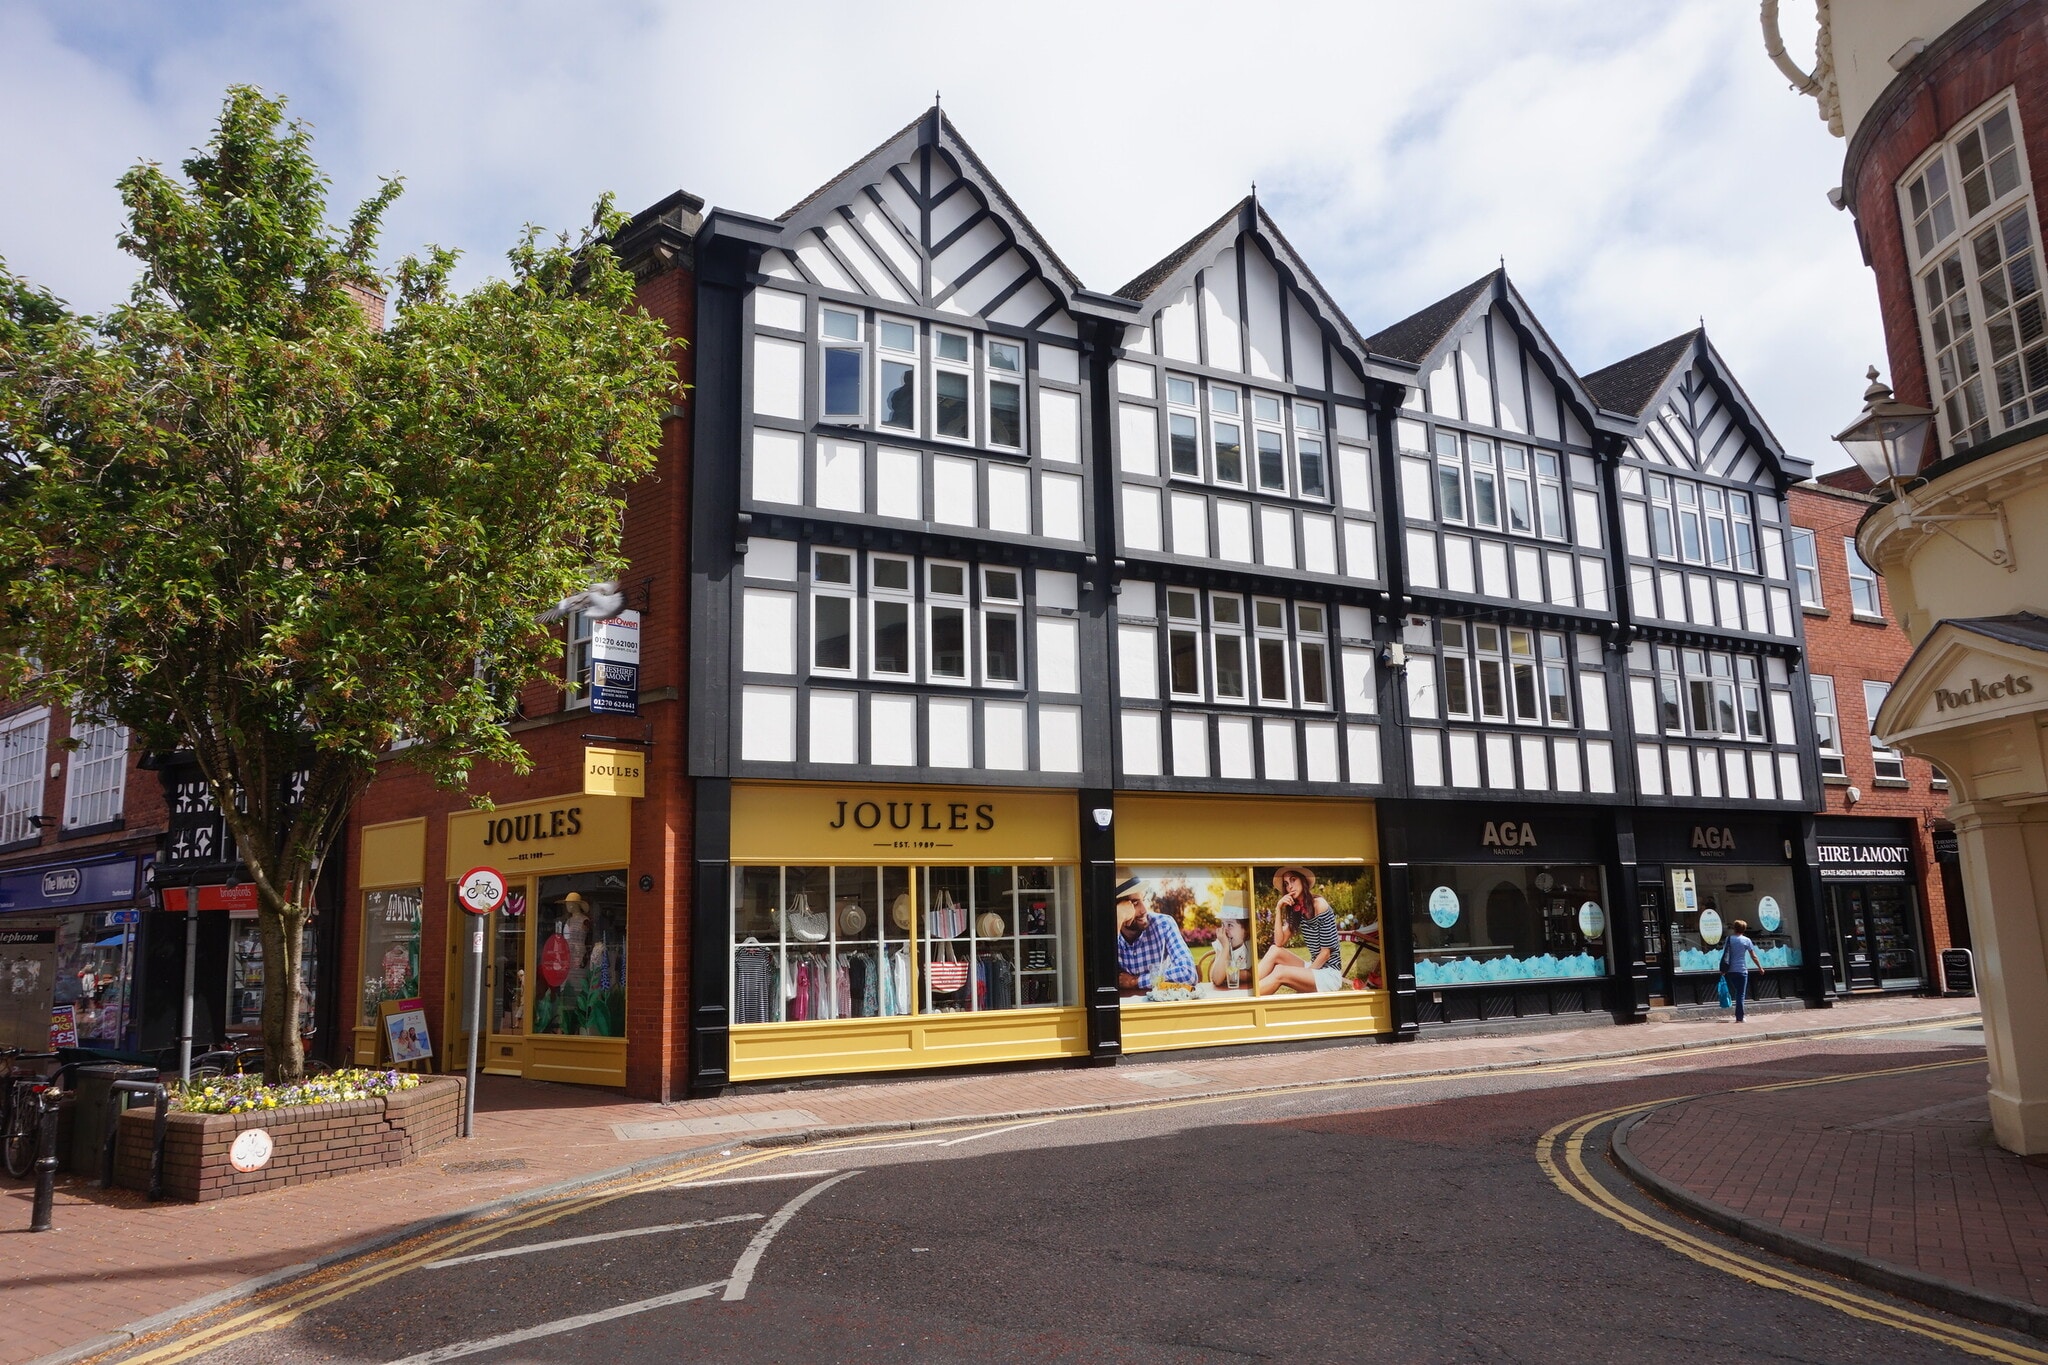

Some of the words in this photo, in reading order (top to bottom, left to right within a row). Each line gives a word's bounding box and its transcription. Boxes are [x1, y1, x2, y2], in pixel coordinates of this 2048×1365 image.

[594, 636, 614, 646] 01270
[616, 640, 638, 649] 621001
[597, 665, 633, 676] CHESHIRE
[600, 671, 631, 682] LAMONT
[1934, 674, 2033, 712] Pockets
[593, 698, 613, 707] 01270
[613, 700, 635, 709] 624441
[590, 765, 639, 778] JOULES
[830, 801, 994, 830] JOULES
[484, 807, 581, 846] JOULES
[1483, 821, 1537, 847] AGA
[1692, 826, 1736, 849] AGA
[913, 841, 935, 849] 1989
[1493, 848, 1524, 856] NANTWICH
[1817, 846, 1851, 862] HIRE
[1852, 846, 1910, 862] LAMONT
[44, 878, 55, 891] The
[56, 874, 76, 890] Works
[0, 932, 39, 944] lephone
[52, 1015, 66, 1023] IDS
[57, 1031, 75, 1043] £5
